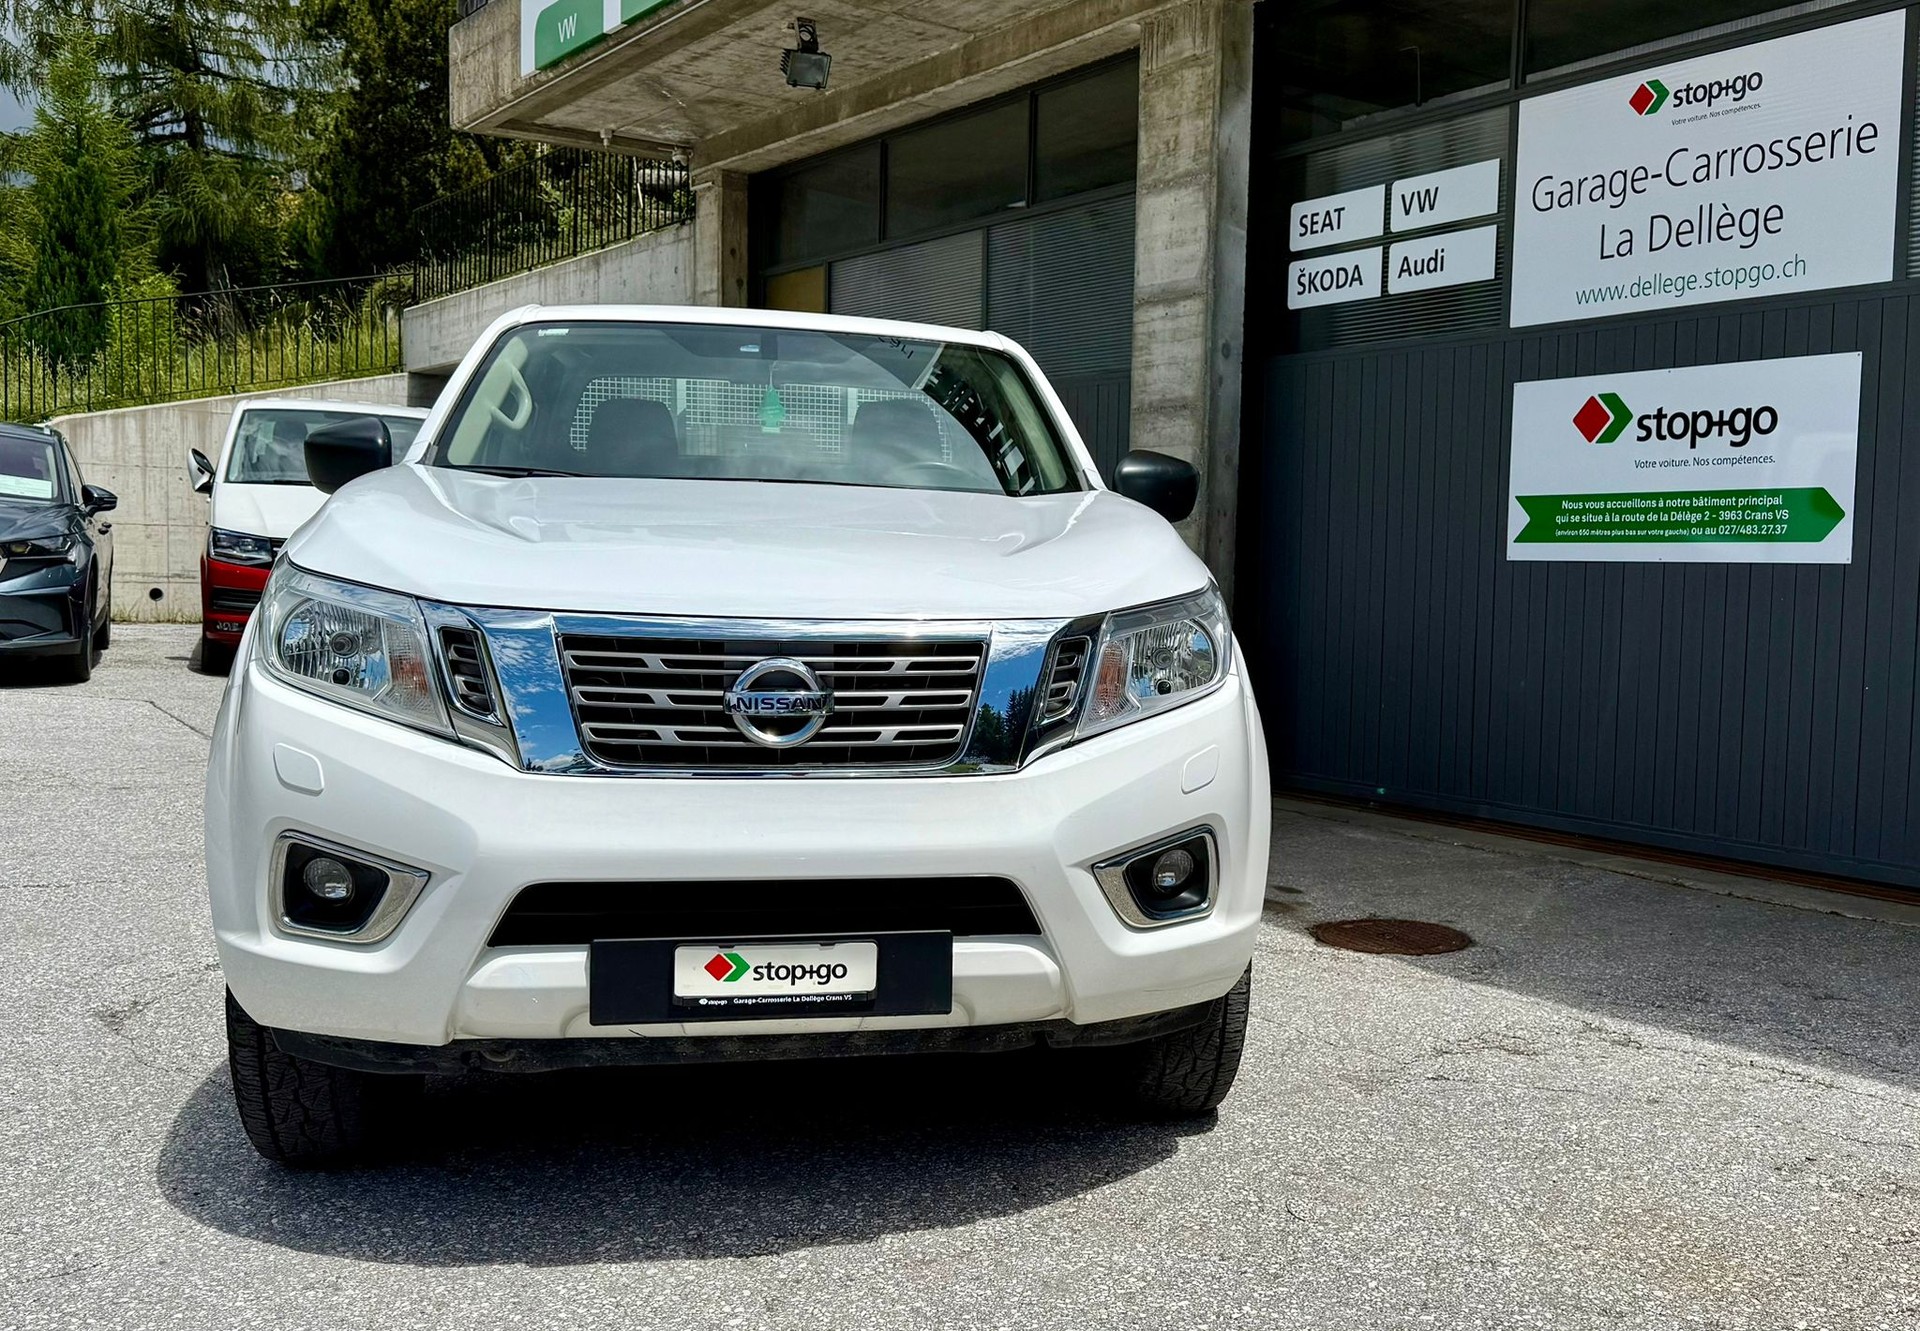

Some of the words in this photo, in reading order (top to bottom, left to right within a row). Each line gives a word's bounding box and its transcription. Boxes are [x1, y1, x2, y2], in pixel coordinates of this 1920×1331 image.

[558, 13, 577, 43] VW
[1672, 71, 1763, 108] stop+go
[1687, 114, 1708, 122] voiture.
[1721, 103, 1761, 116] compétences.
[1531, 114, 1879, 212] Garage-Carrosserie
[1401, 186, 1439, 216] VW
[1299, 206, 1345, 238] SEAT
[1599, 224, 1633, 260] La
[1648, 202, 1784, 249] Dellège
[1398, 248, 1445, 279] Audi
[1297, 264, 1363, 296] ŠKODA
[1575, 253, 1806, 306] www.dellege.stopgo.ch
[1636, 405, 1778, 449] stop+go
[1634, 459, 1657, 469] Votre
[1659, 457, 1691, 468] voiture.
[1693, 457, 1710, 466] Nos
[1711, 454, 1776, 467] compétences.
[1555, 513, 1569, 525] qui
[1570, 514, 1581, 523] se
[1581, 512, 1603, 523] situe
[1604, 512, 1610, 522] à
[1611, 512, 1620, 522] la
[1621, 513, 1645, 522] route
[1646, 512, 1658, 522] de
[1660, 511, 1668, 521] la
[1670, 511, 1702, 524] Délège
[1703, 511, 1710, 521] 2
[1718, 510, 1742, 520] 3963
[1744, 510, 1773, 520] Crans
[1775, 509, 1789, 520] VS
[1561, 500, 1584, 510] Nous
[1584, 501, 1605, 509] vous
[1606, 498, 1657, 509] accueillons
[1658, 497, 1664, 508] à
[1665, 498, 1691, 507] notre
[1692, 496, 1736, 507] bâtiment
[1738, 494, 1783, 508] principal
[1555, 529, 1578, 537] (environ
[1611, 529, 1625, 537] plus
[1664, 528, 1690, 537] gauche)
[1691, 526, 1703, 535] ou
[1704, 526, 1717, 535] au
[1718, 524, 1788, 535] 027/483.27.37
[736, 697, 826, 710] NISSAN
[753, 960, 848, 986] stop+go
[733, 996, 792, 1005] Garage-Carrosserie
